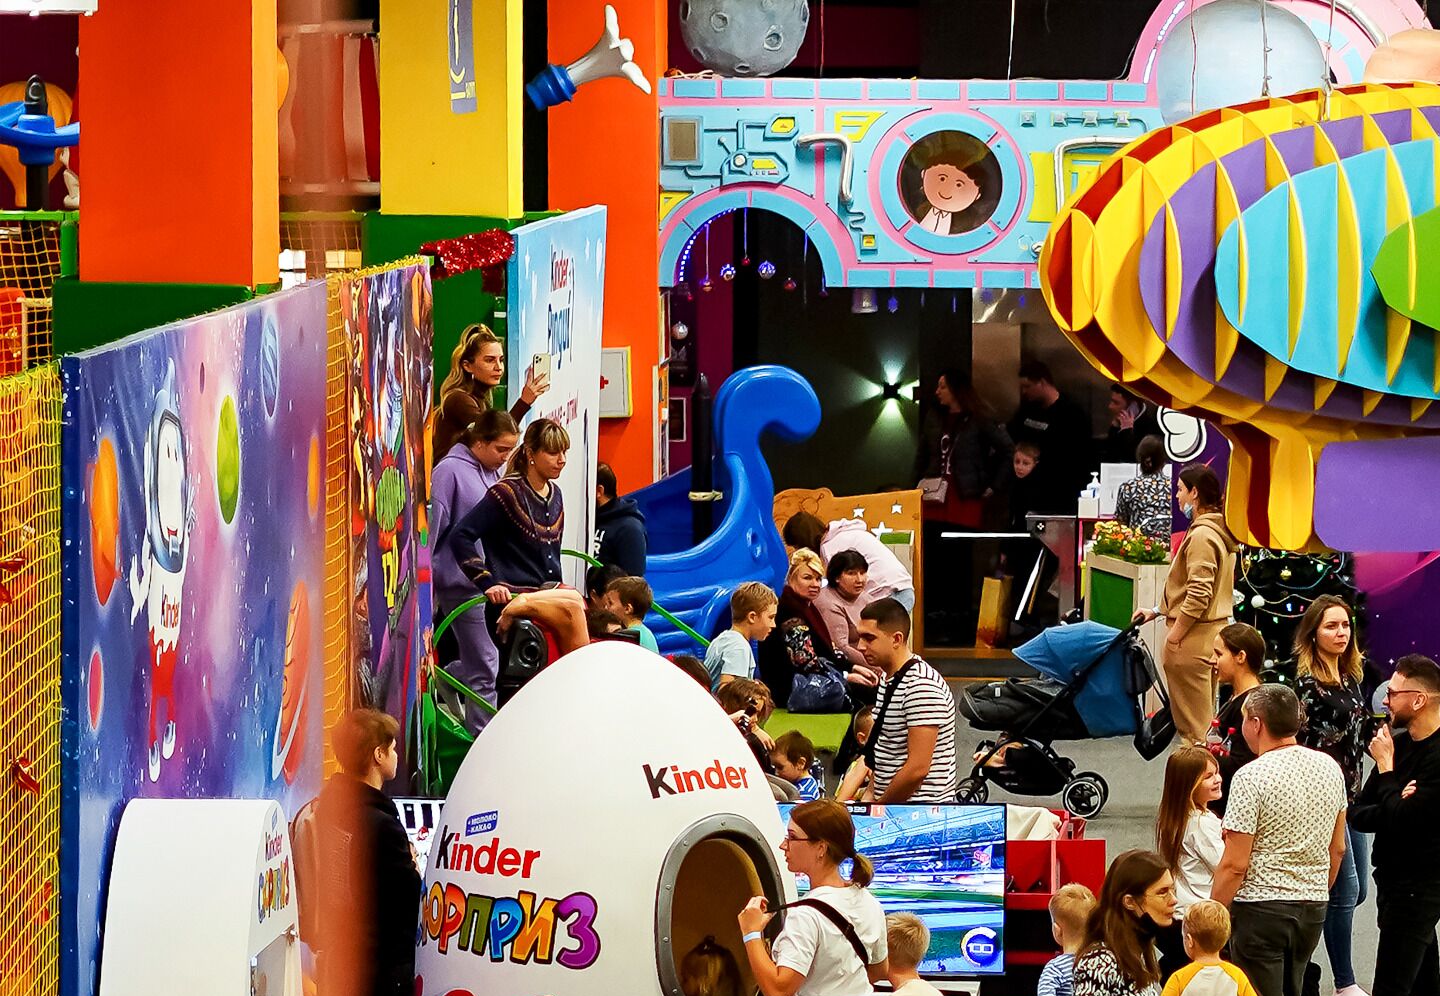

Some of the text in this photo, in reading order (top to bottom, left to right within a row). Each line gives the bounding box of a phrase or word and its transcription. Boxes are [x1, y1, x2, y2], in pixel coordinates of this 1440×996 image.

[641, 759, 749, 799] Kinder
[435, 825, 541, 879] Kinder
[416, 879, 602, 970] ЮРПРИЗ
[966, 942, 994, 954] 100
